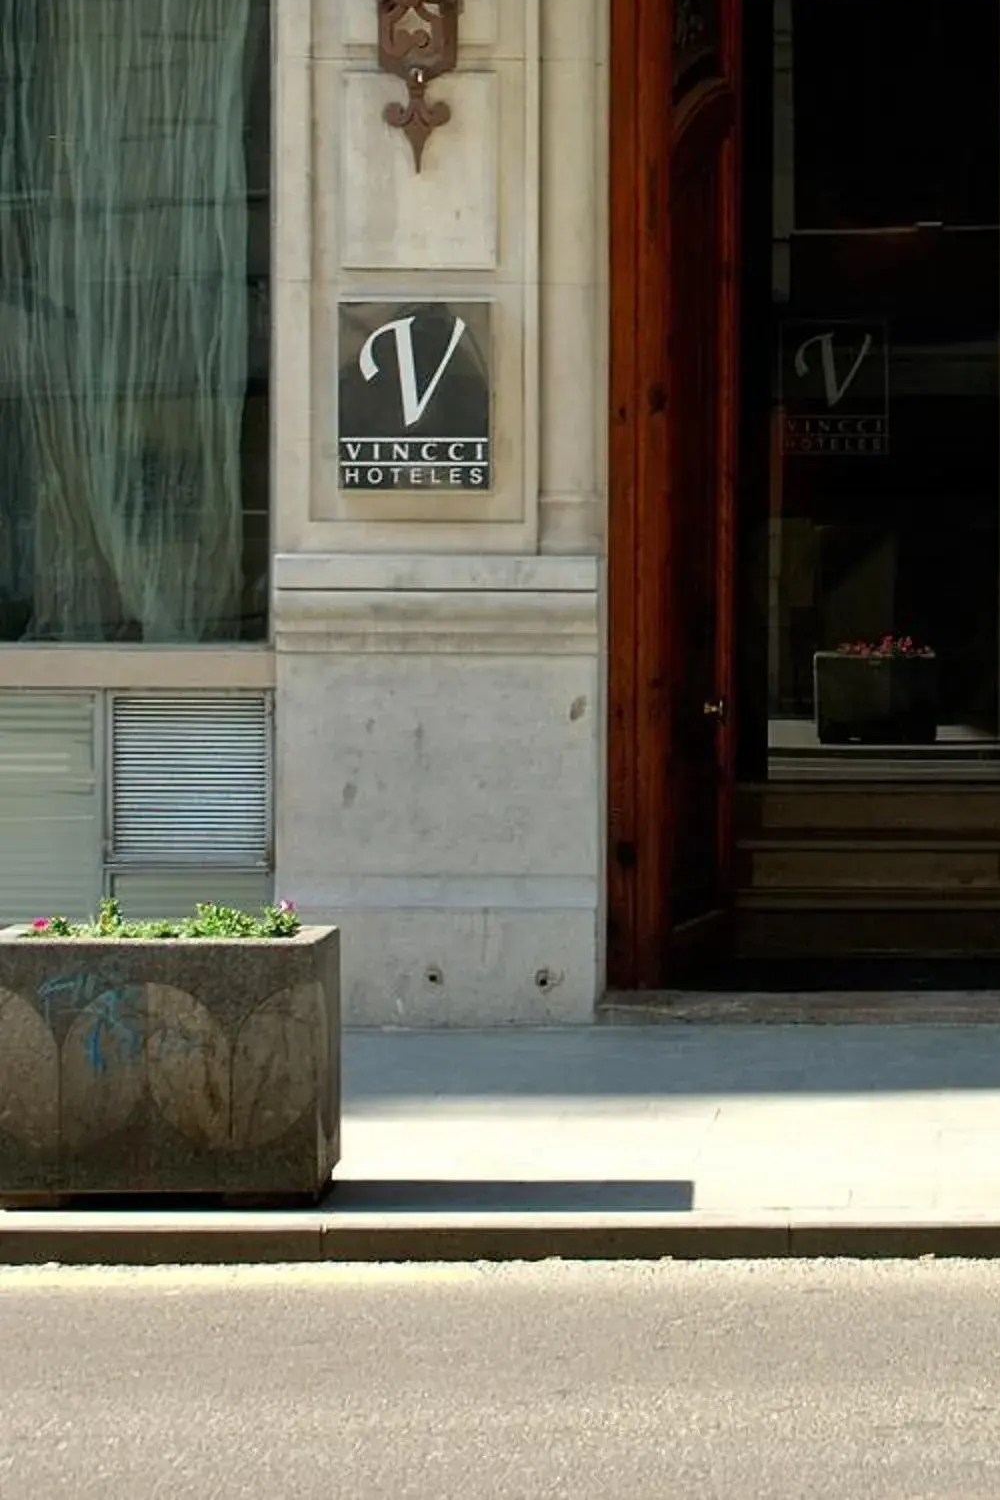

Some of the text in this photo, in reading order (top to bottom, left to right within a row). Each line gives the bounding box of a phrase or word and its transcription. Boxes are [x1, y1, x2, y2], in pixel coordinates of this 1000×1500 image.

[359, 316, 466, 427] V
[795, 330, 872, 407] V
[346, 443, 484, 460] VINCCI
[345, 468, 484, 485] HOTELES
